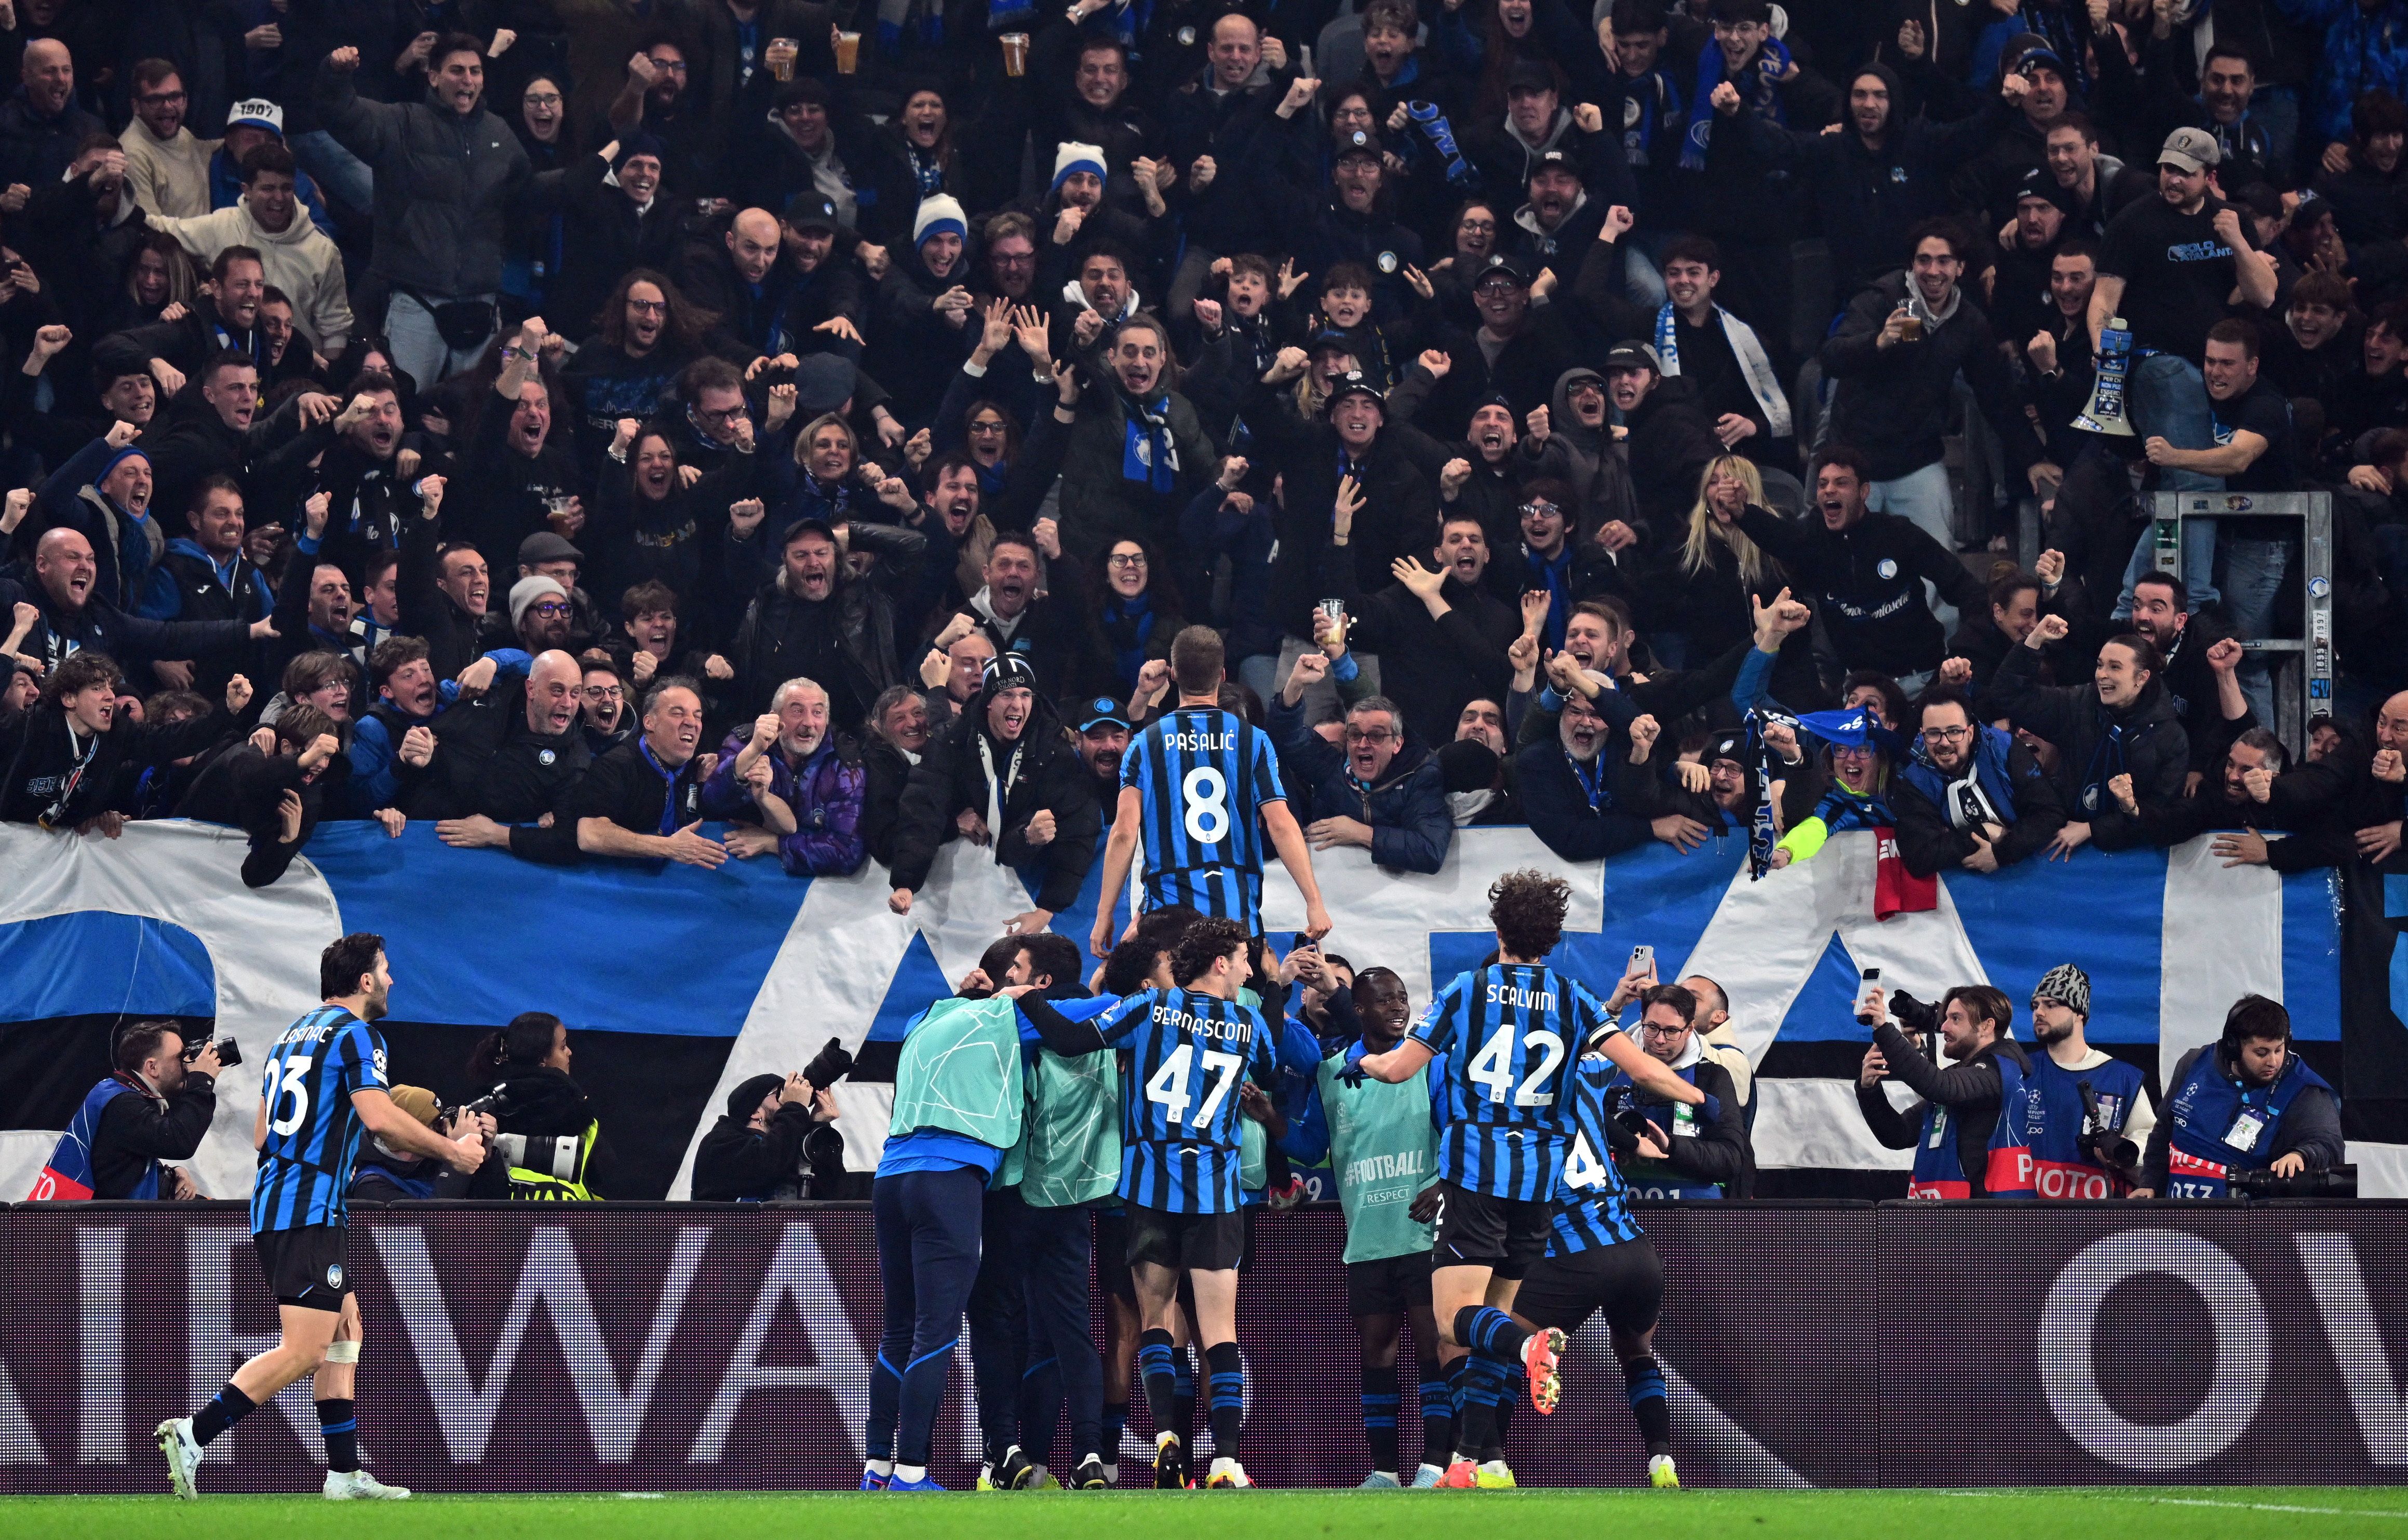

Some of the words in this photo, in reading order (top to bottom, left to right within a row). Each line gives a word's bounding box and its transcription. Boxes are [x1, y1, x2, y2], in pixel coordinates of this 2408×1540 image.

[241, 104, 273, 117] 1907
[1007, 676, 1025, 685] NORD
[1164, 729, 1235, 752] PAŠALIĆ
[1182, 766, 1230, 844] 8
[1487, 983, 1556, 1012] SCALVINI
[274, 1023, 333, 1045] OLAŠINAC
[1152, 1005, 1252, 1044] BERNASCONI
[1468, 1024, 1565, 1107] 42
[264, 1055, 313, 1136] 23
[1146, 1043, 1243, 1129] 47
[1345, 1148, 1425, 1188] #FOOTBALL
[1367, 1188, 1410, 1204] RESPECT
